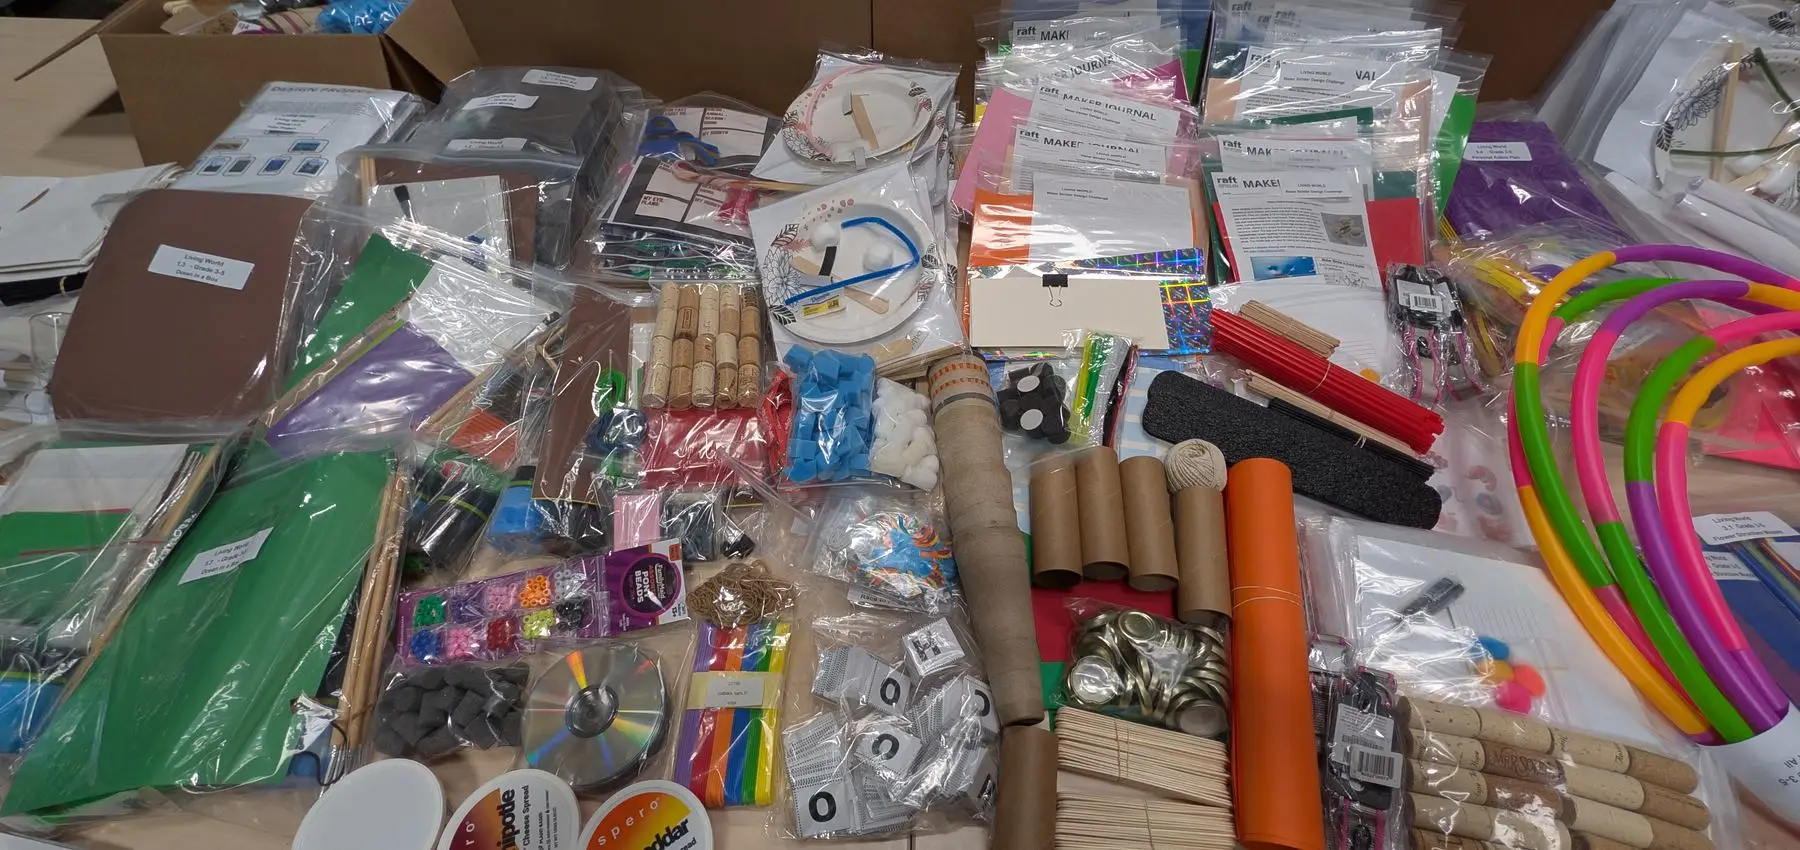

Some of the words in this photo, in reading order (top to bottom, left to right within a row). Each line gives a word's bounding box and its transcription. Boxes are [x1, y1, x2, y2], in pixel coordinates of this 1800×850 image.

[1016, 26, 1037, 36] raft
[1040, 30, 1070, 41] MAK
[1040, 86, 1060, 95] raft
[1105, 103, 1157, 121] JOURNAL
[1019, 129, 1040, 139] raft
[1222, 140, 1242, 149] raft
[1247, 146, 1273, 156] MAK
[1216, 176, 1238, 184] raft
[184, 254, 204, 263] Living
[205, 258, 225, 267] World
[194, 264, 213, 273] Grade
[214, 268, 225, 276] 3-5
[205, 274, 218, 283] Box
[635, 570, 644, 603] BEADS
[642, 570, 651, 598] PONY
[1783, 757, 1799, 769] All
[1778, 775, 1799, 786] 3-5
[522, 784, 531, 814] Spread
[598, 797, 659, 846] spero
[522, 814, 530, 847] Cheese
